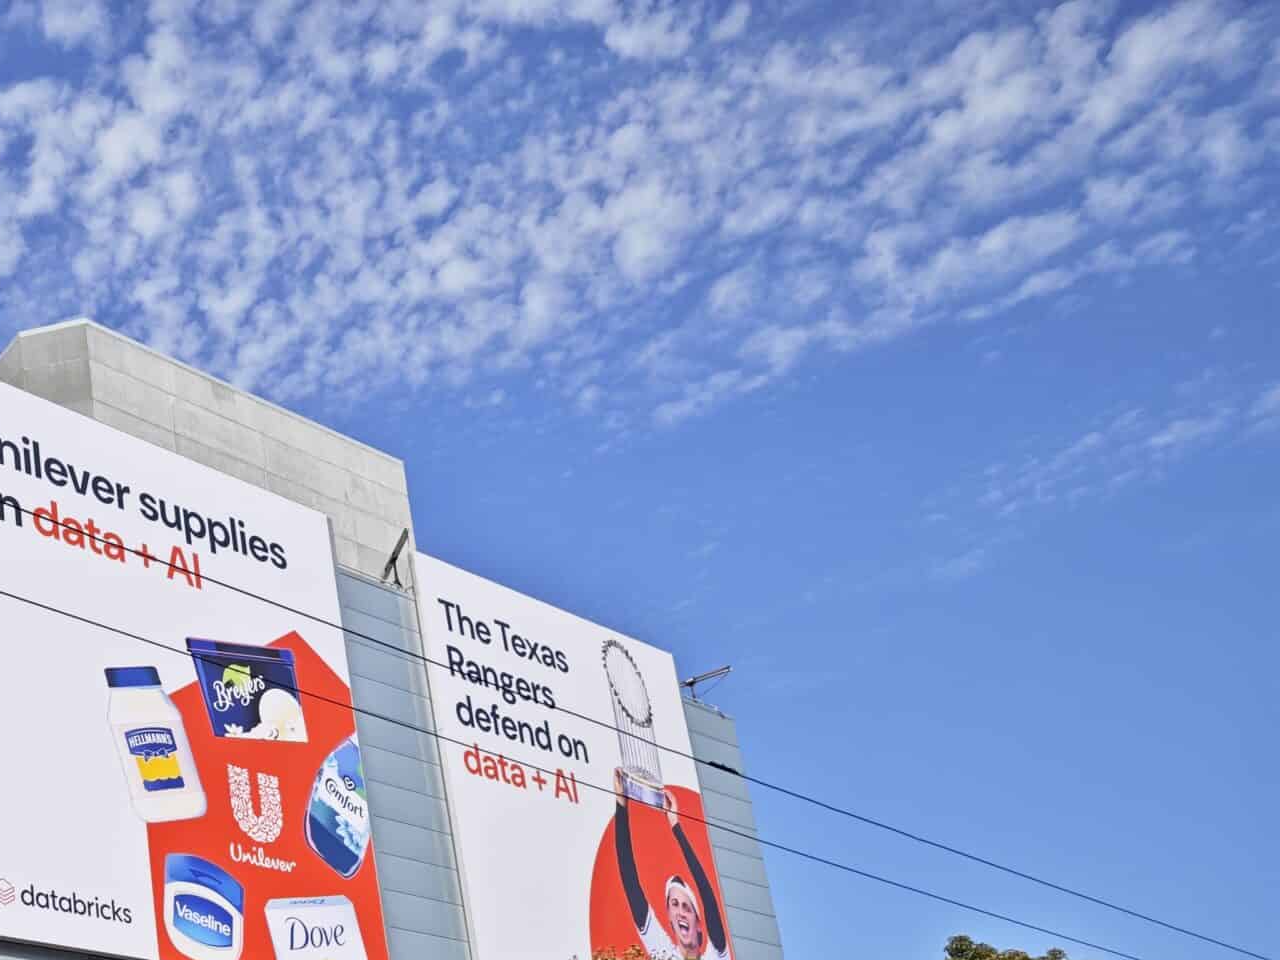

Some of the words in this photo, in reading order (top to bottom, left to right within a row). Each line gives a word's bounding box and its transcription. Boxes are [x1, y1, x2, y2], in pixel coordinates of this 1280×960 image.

[32, 501, 126, 564] data
[167, 545, 203, 590] AI
[139, 490, 288, 570] supplies
[437, 597, 492, 645] The
[493, 619, 569, 673] Texas
[212, 675, 266, 713] Breyers
[446, 644, 556, 710] Rangers
[455, 695, 553, 753] defend
[557, 732, 590, 764] on
[463, 743, 528, 789] data
[554, 768, 579, 804] AI
[229, 841, 297, 873] Unilever
[20, 883, 133, 924] databricks
[175, 900, 232, 937] Vaseline
[284, 916, 346, 951] Dove
